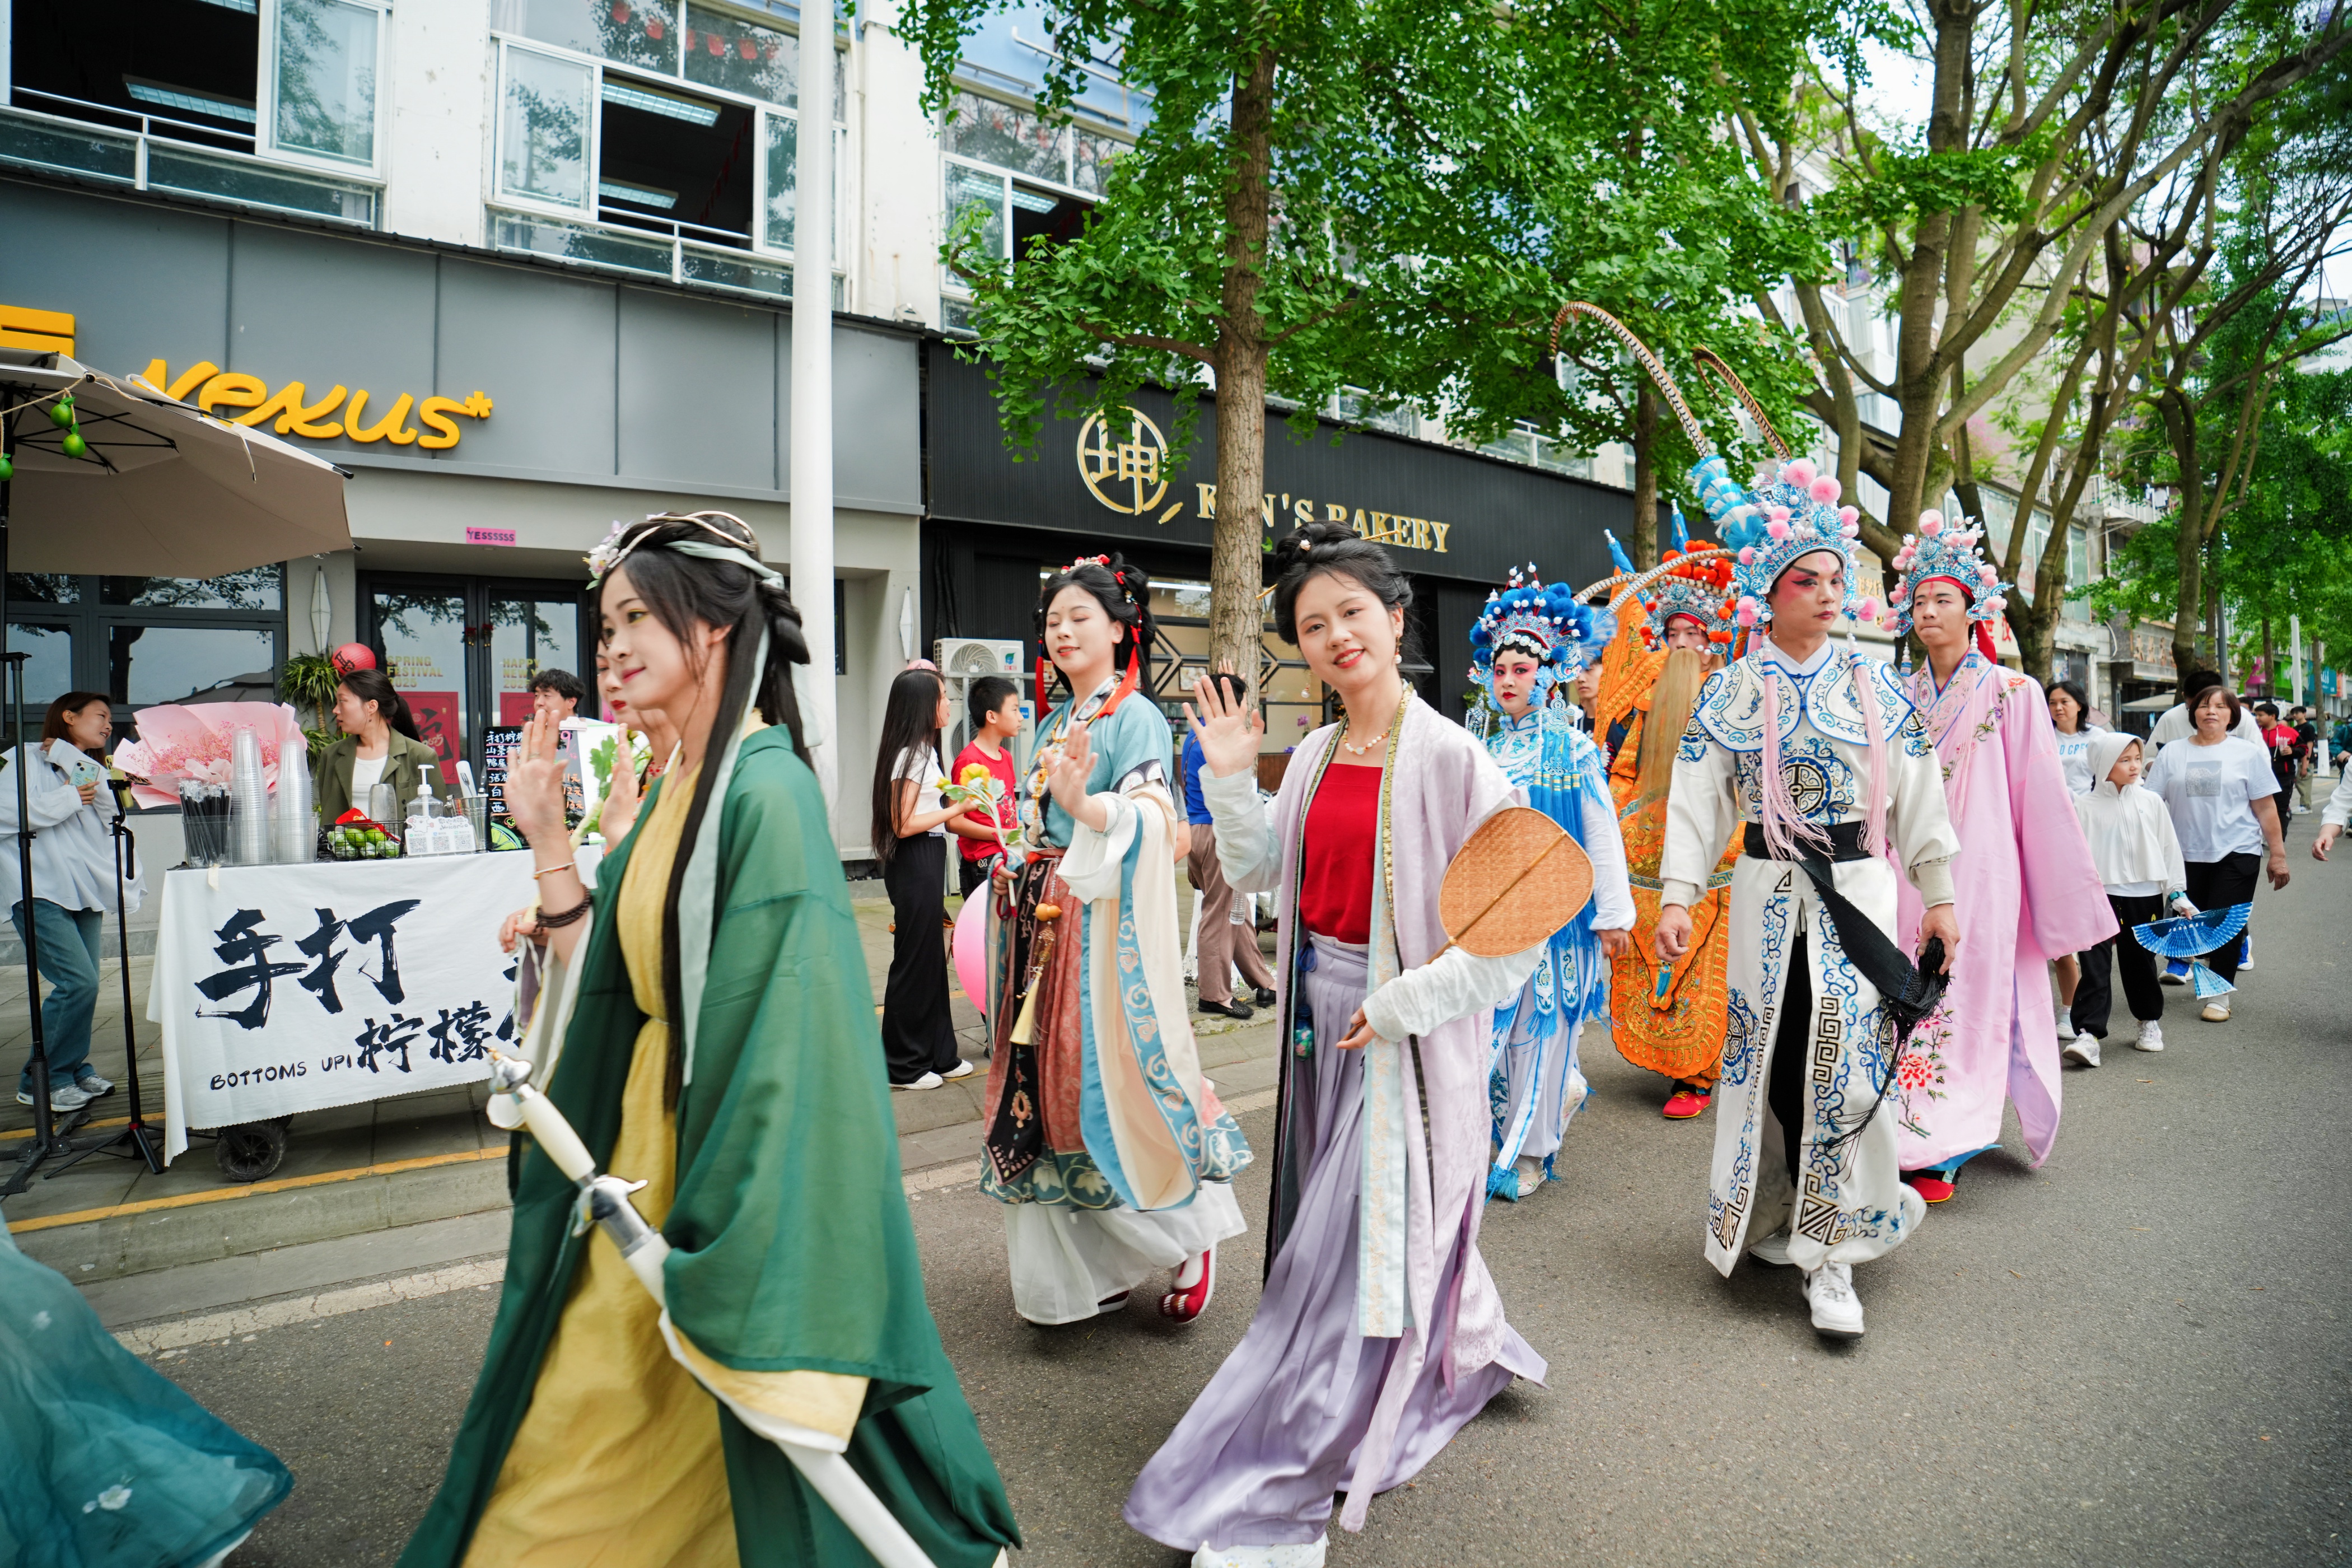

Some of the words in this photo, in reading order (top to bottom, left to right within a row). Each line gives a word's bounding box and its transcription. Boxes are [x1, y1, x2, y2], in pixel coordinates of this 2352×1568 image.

[1196, 483, 1314, 529] KN'S
[386, 656, 431, 666] SPRING
[503, 658, 540, 668] HAPPY
[386, 666, 444, 677] FESTIVAL
[503, 669, 527, 678] NEW
[194, 899, 423, 1030] 手打
[211, 1061, 307, 1090] BOTTOMS
